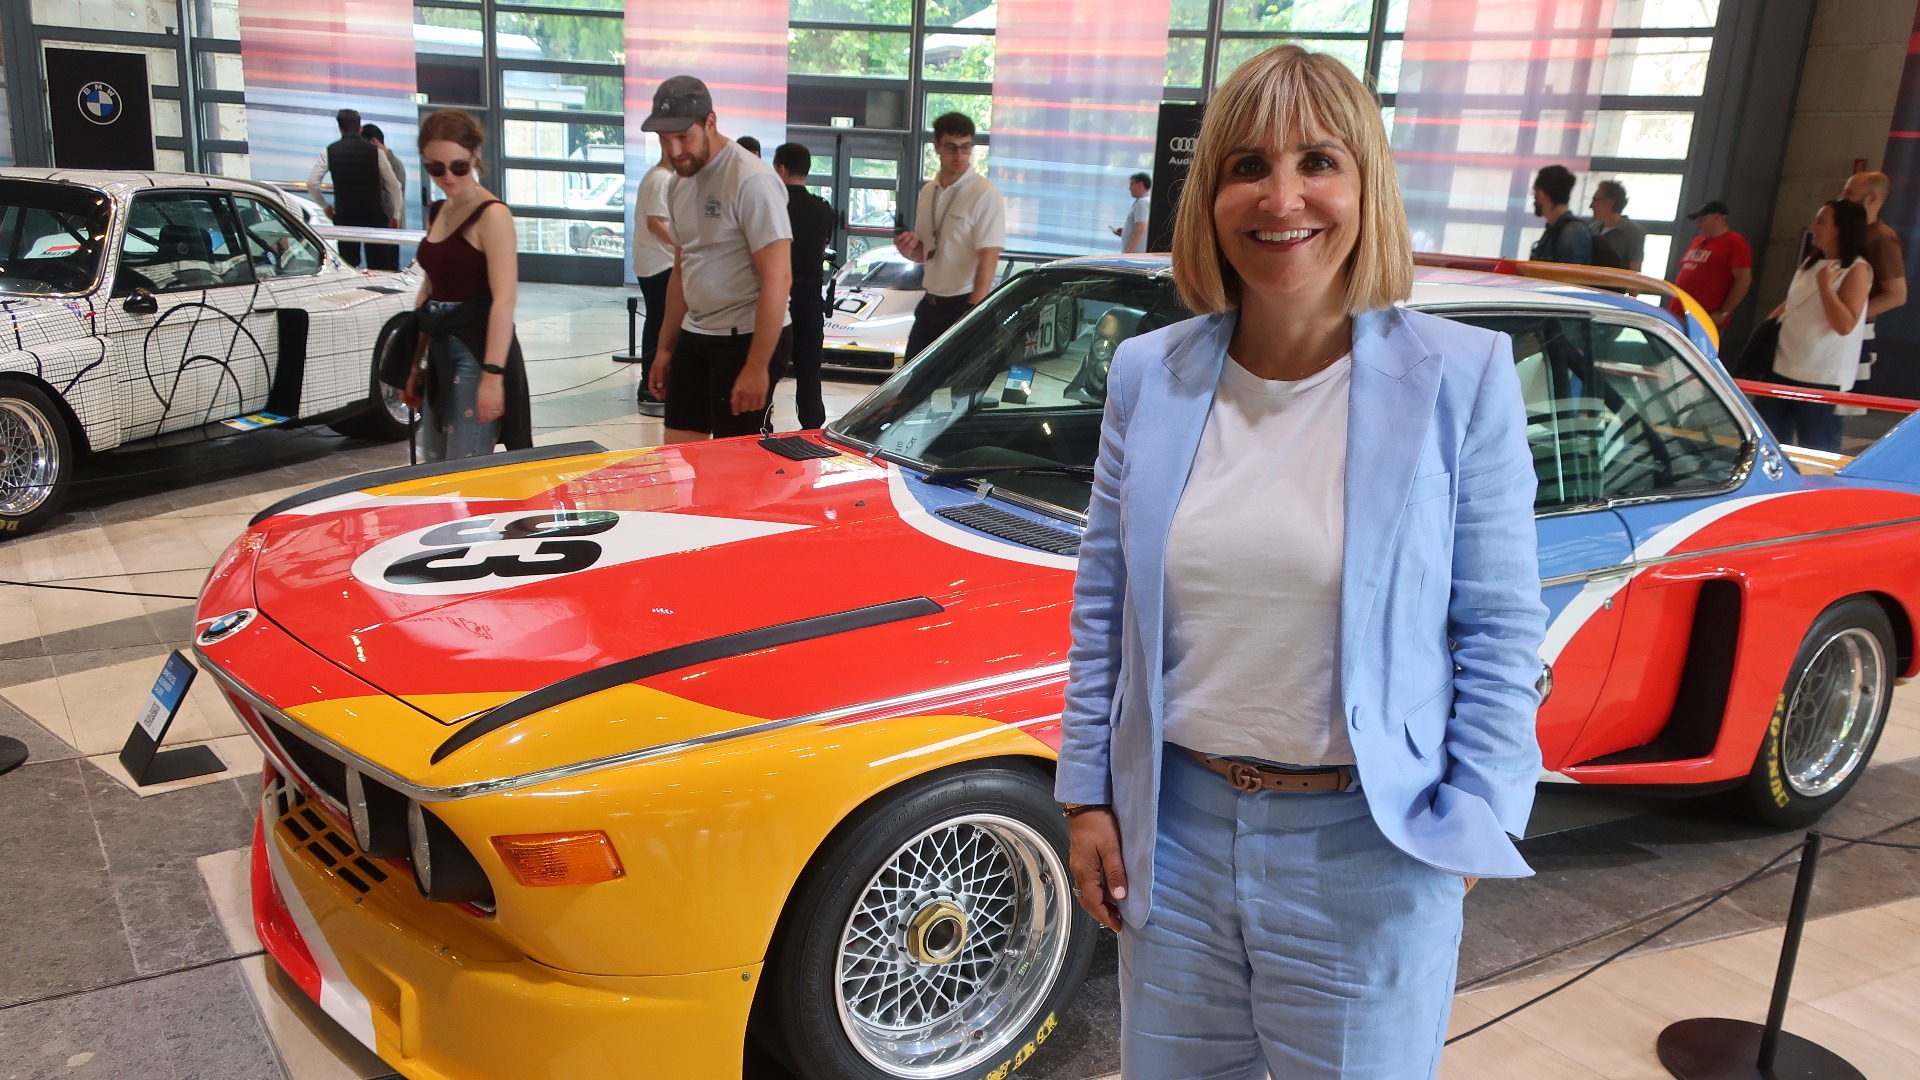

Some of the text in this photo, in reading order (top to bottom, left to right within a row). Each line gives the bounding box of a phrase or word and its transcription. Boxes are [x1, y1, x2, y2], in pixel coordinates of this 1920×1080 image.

[83, 84, 115, 97] BMW
[1040, 321, 1053, 348] 10
[383, 511, 620, 585] 93
